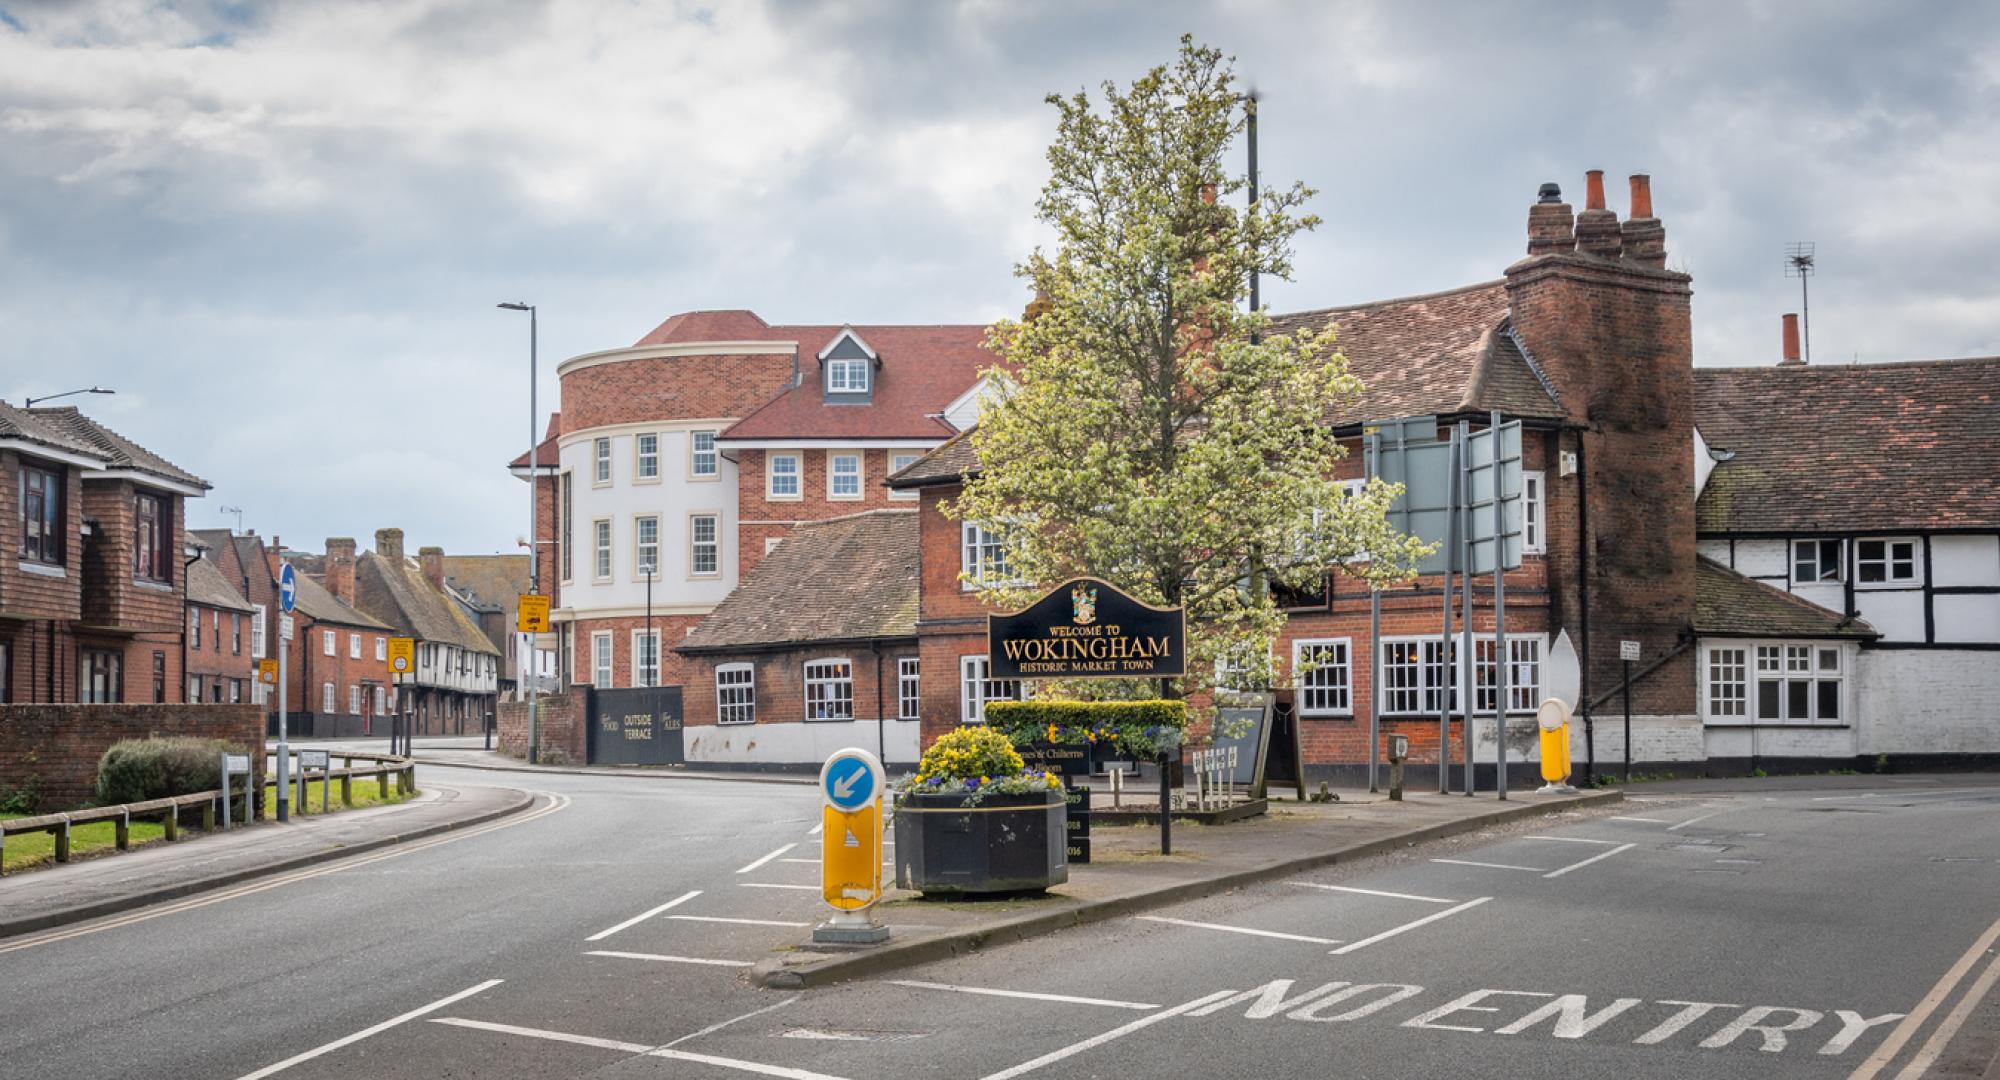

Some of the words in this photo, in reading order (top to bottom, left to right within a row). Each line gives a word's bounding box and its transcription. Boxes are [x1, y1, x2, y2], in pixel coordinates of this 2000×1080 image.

[1050, 626, 1102, 637] WELCOME
[1105, 625, 1121, 636] TO
[1003, 636, 1171, 661] WOKINGHAM
[1019, 662, 1067, 673] HISTORIC
[1072, 661, 1116, 672] MARKET
[1122, 660, 1154, 670] TOWN
[624, 714, 652, 726] OUTSIDE
[624, 728, 652, 740] TERRACE
[1183, 979, 1424, 1023] NO
[1401, 988, 1906, 1055] ENTRY
